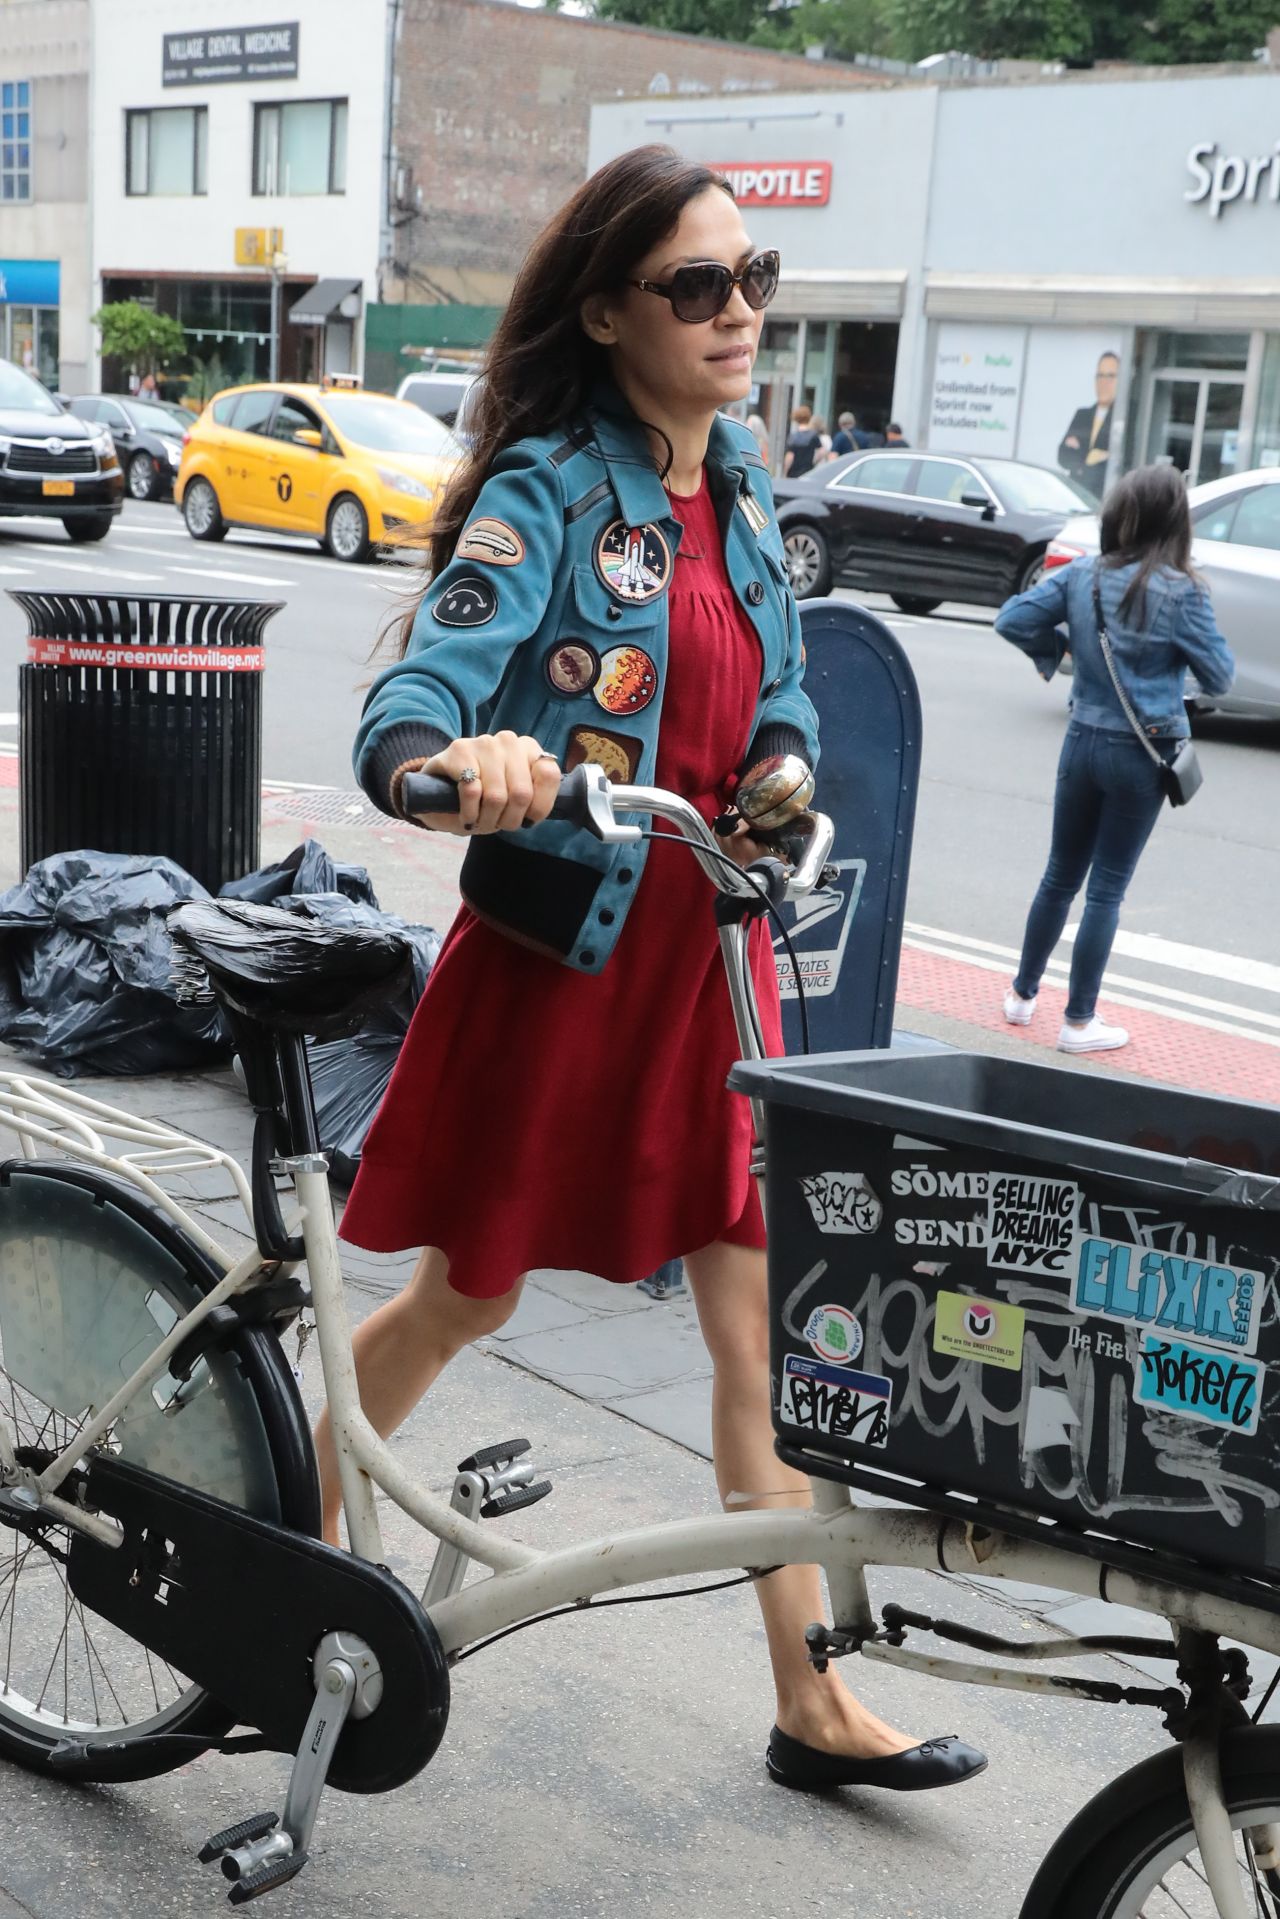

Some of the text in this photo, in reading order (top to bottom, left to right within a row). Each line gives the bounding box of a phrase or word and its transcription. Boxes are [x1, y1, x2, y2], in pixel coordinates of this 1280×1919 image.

[168, 30, 292, 61] VILLAGE DENTAL MEDICINE
[717, 169, 823, 197] IPOTLE
[984, 353, 1013, 367] hulu
[935, 382, 1017, 397] Unlimited from
[934, 399, 993, 413] Sprint now
[933, 415, 978, 429] includes
[69, 647, 260, 670] www.greenwichvillage.nyc
[786, 975, 831, 990] SERVICE
[992, 1178, 1075, 1218] SELLING
[991, 1209, 1074, 1249] DREAMS
[991, 1242, 1072, 1271] NYC
[1233, 1272, 1256, 1347] COFFEE
[806, 1308, 825, 1341] Orono
[848, 1322, 861, 1357] BREWING
[1068, 1326, 1092, 1352] De
